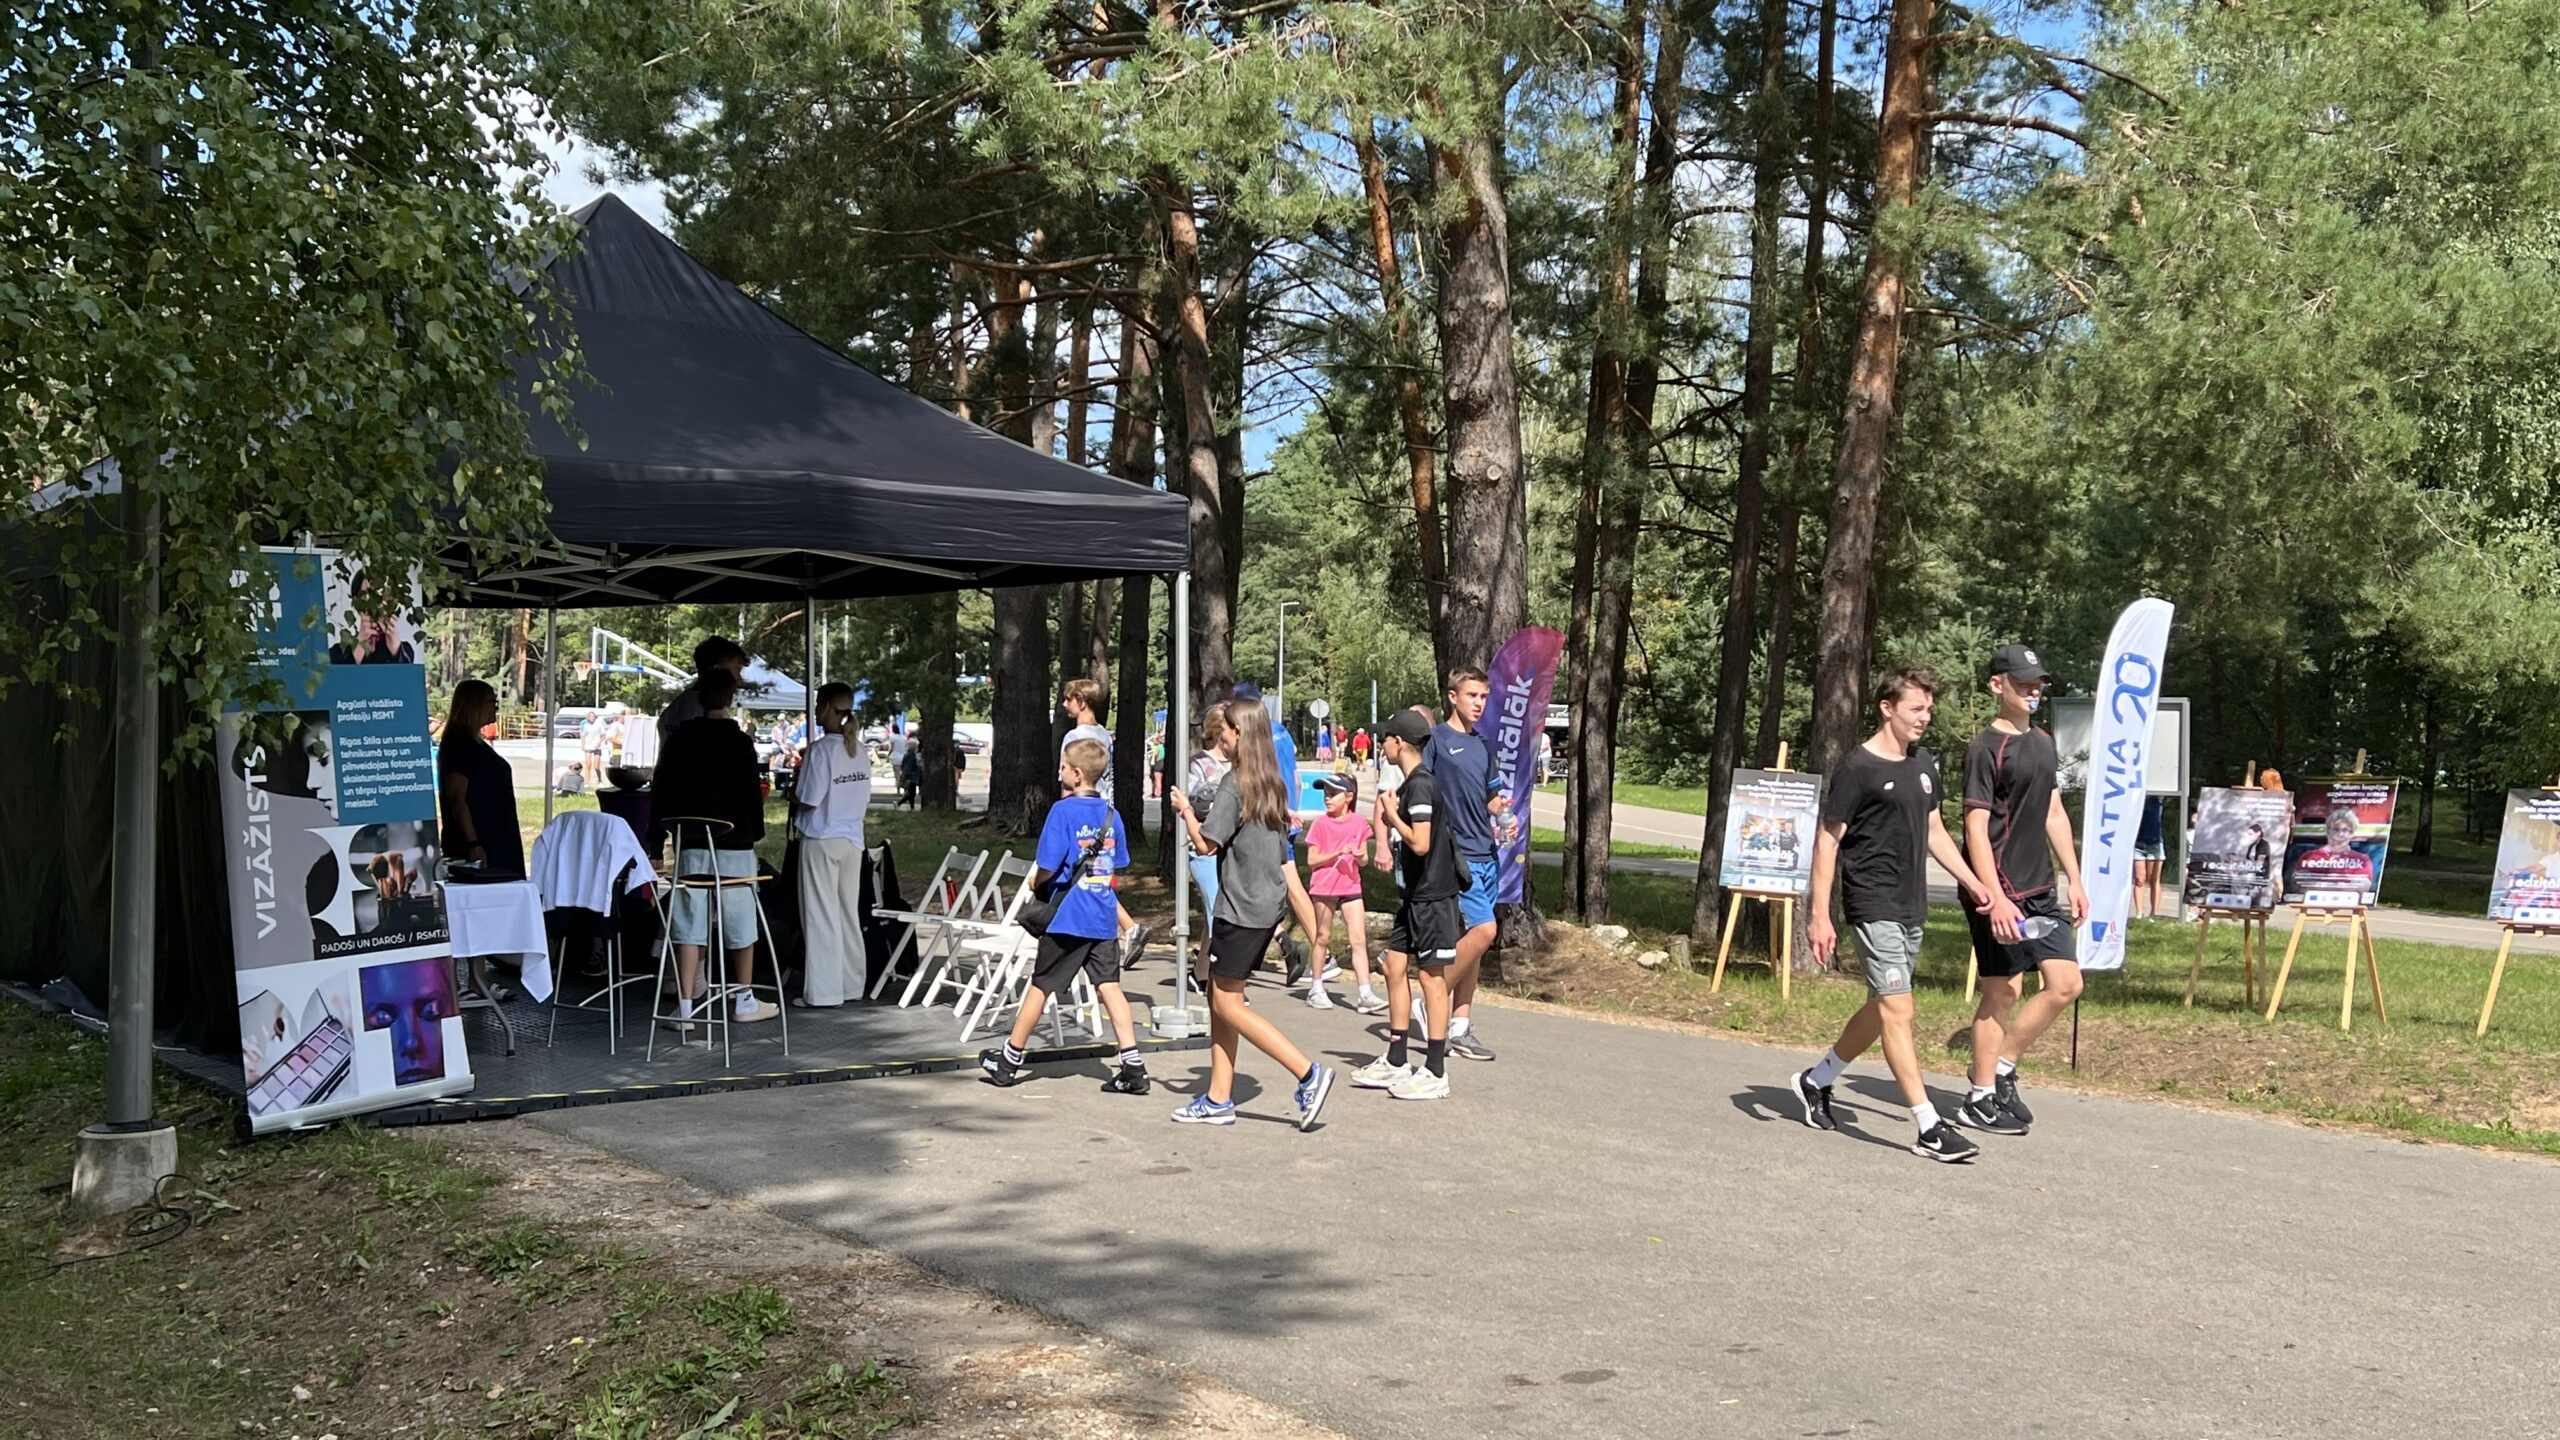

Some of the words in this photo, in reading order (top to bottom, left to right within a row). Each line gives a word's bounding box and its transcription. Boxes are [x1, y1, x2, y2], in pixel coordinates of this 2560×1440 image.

[372, 710, 395, 720] RSMT
[395, 734, 422, 743] modes
[384, 748, 398, 758] top
[399, 748, 411, 756] un
[343, 788, 354, 796] un
[243, 745, 277, 940] VIZĀŽISTS
[321, 940, 355, 953] RADOŠI
[357, 939, 371, 949] UN
[372, 934, 405, 947] DAROŠI
